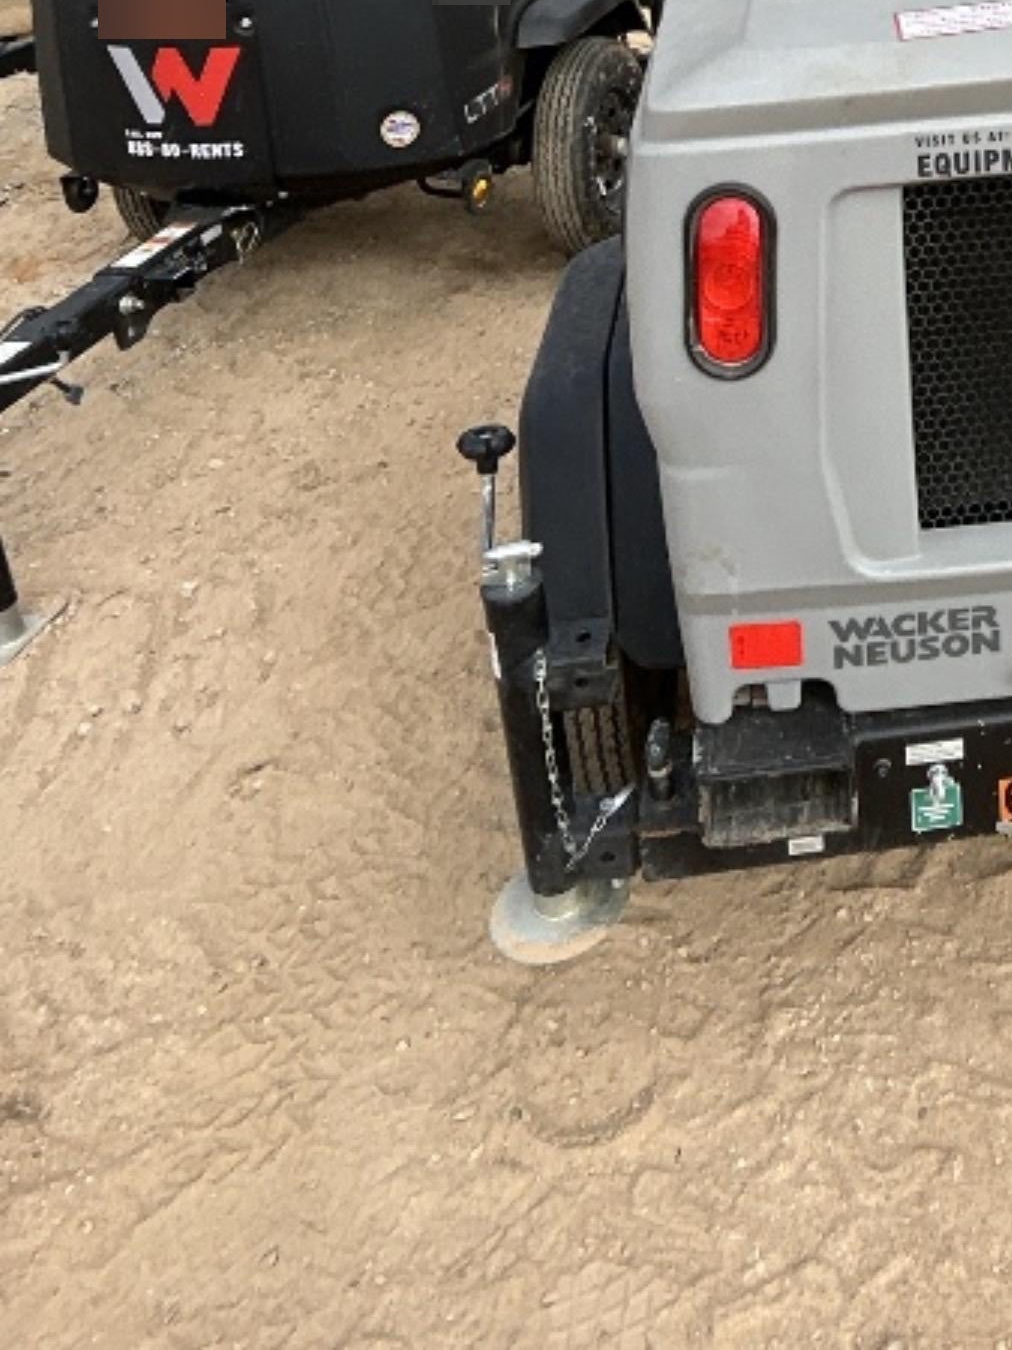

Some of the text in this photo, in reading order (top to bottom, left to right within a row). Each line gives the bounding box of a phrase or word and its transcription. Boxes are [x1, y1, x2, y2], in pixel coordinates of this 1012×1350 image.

[914, 132, 955, 148] VISIT
[828, 605, 1000, 643] WACKER
[833, 629, 1001, 670] NEUSON
